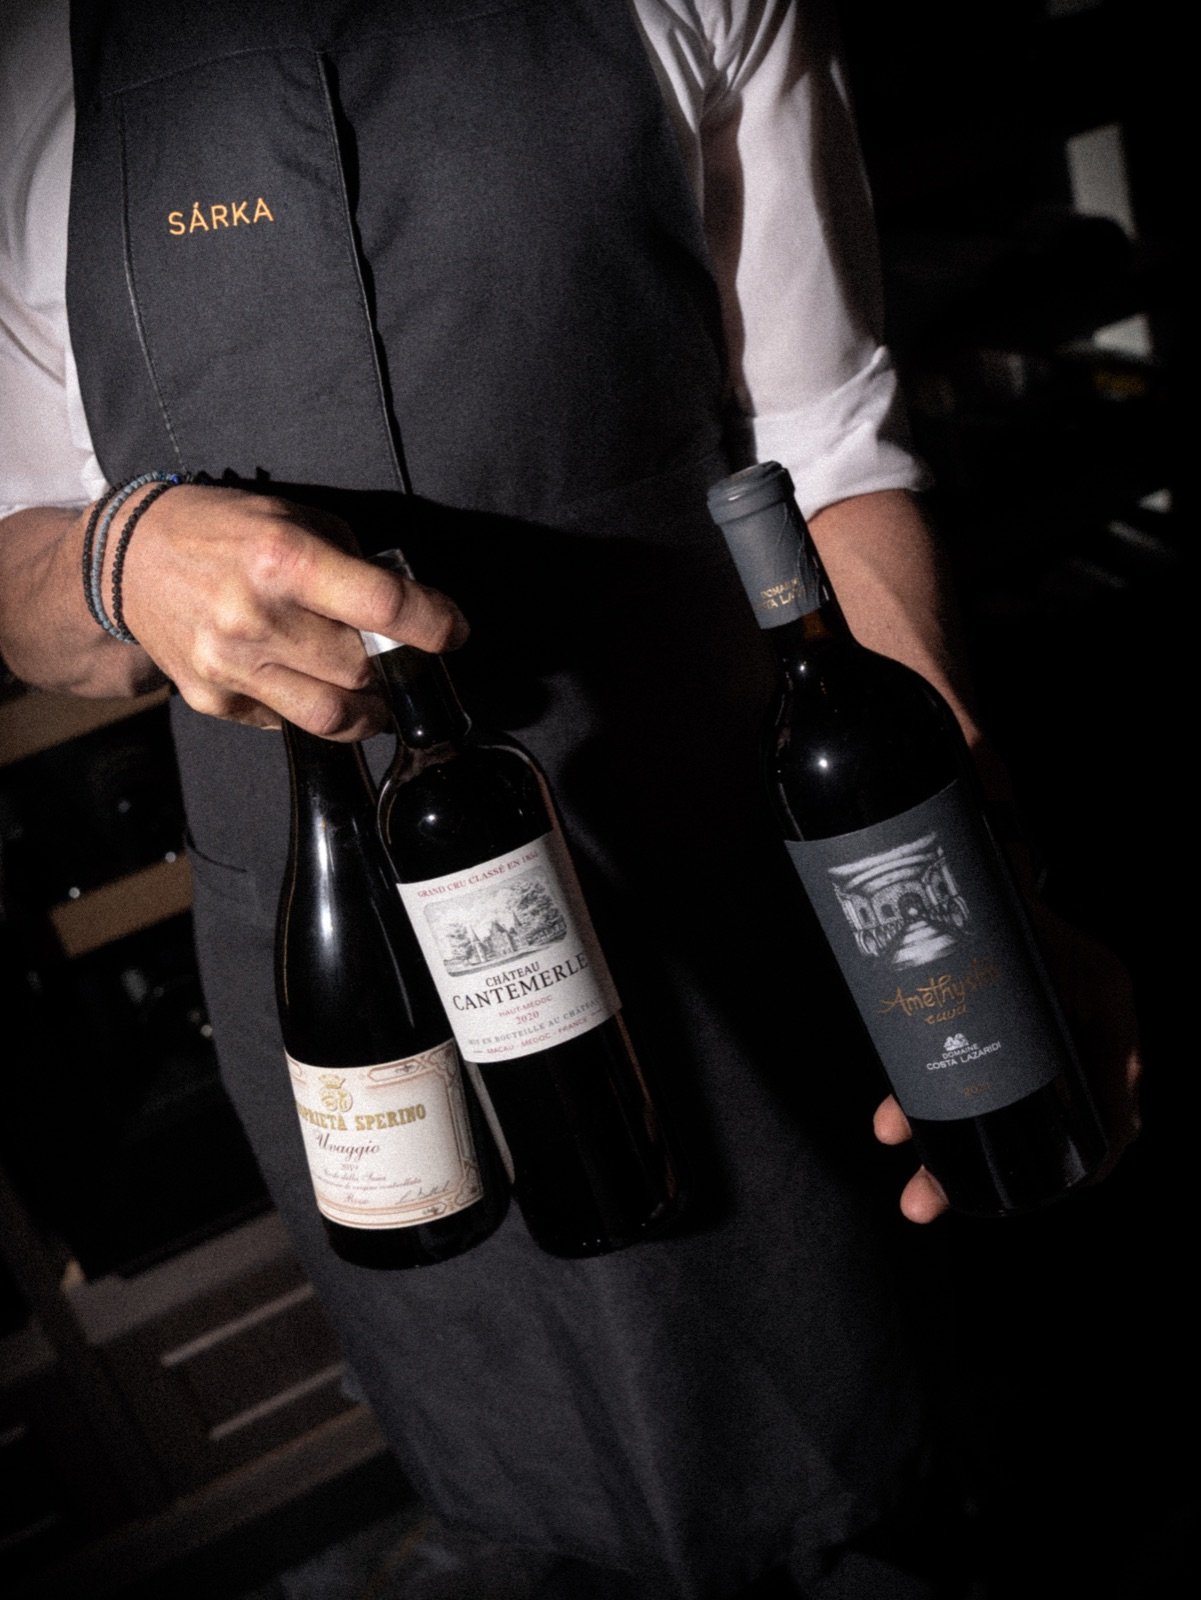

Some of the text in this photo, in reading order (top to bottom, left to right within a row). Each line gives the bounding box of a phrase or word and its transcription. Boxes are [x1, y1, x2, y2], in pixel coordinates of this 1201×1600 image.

[168, 197, 274, 235] SÁRKA
[417, 886, 446, 898] GRAND
[447, 879, 467, 892] CRU
[468, 864, 506, 885] CLASSÉ
[507, 860, 521, 870] EN
[452, 952, 589, 1011] CANTEMERLE
[485, 961, 541, 987] CHÂTEAU
[494, 1024, 545, 1043] BOUTEILLE
[548, 1015, 561, 1027] AU
[515, 1011, 540, 1024] 2020
[486, 1045, 515, 1054] MACAU
[558, 1017, 589, 1033] FRANCE
[926, 1040, 1002, 1070] COSTA LAZARIDI
[941, 1043, 979, 1059] DOMAINE
[355, 1103, 427, 1131] SPERINO
